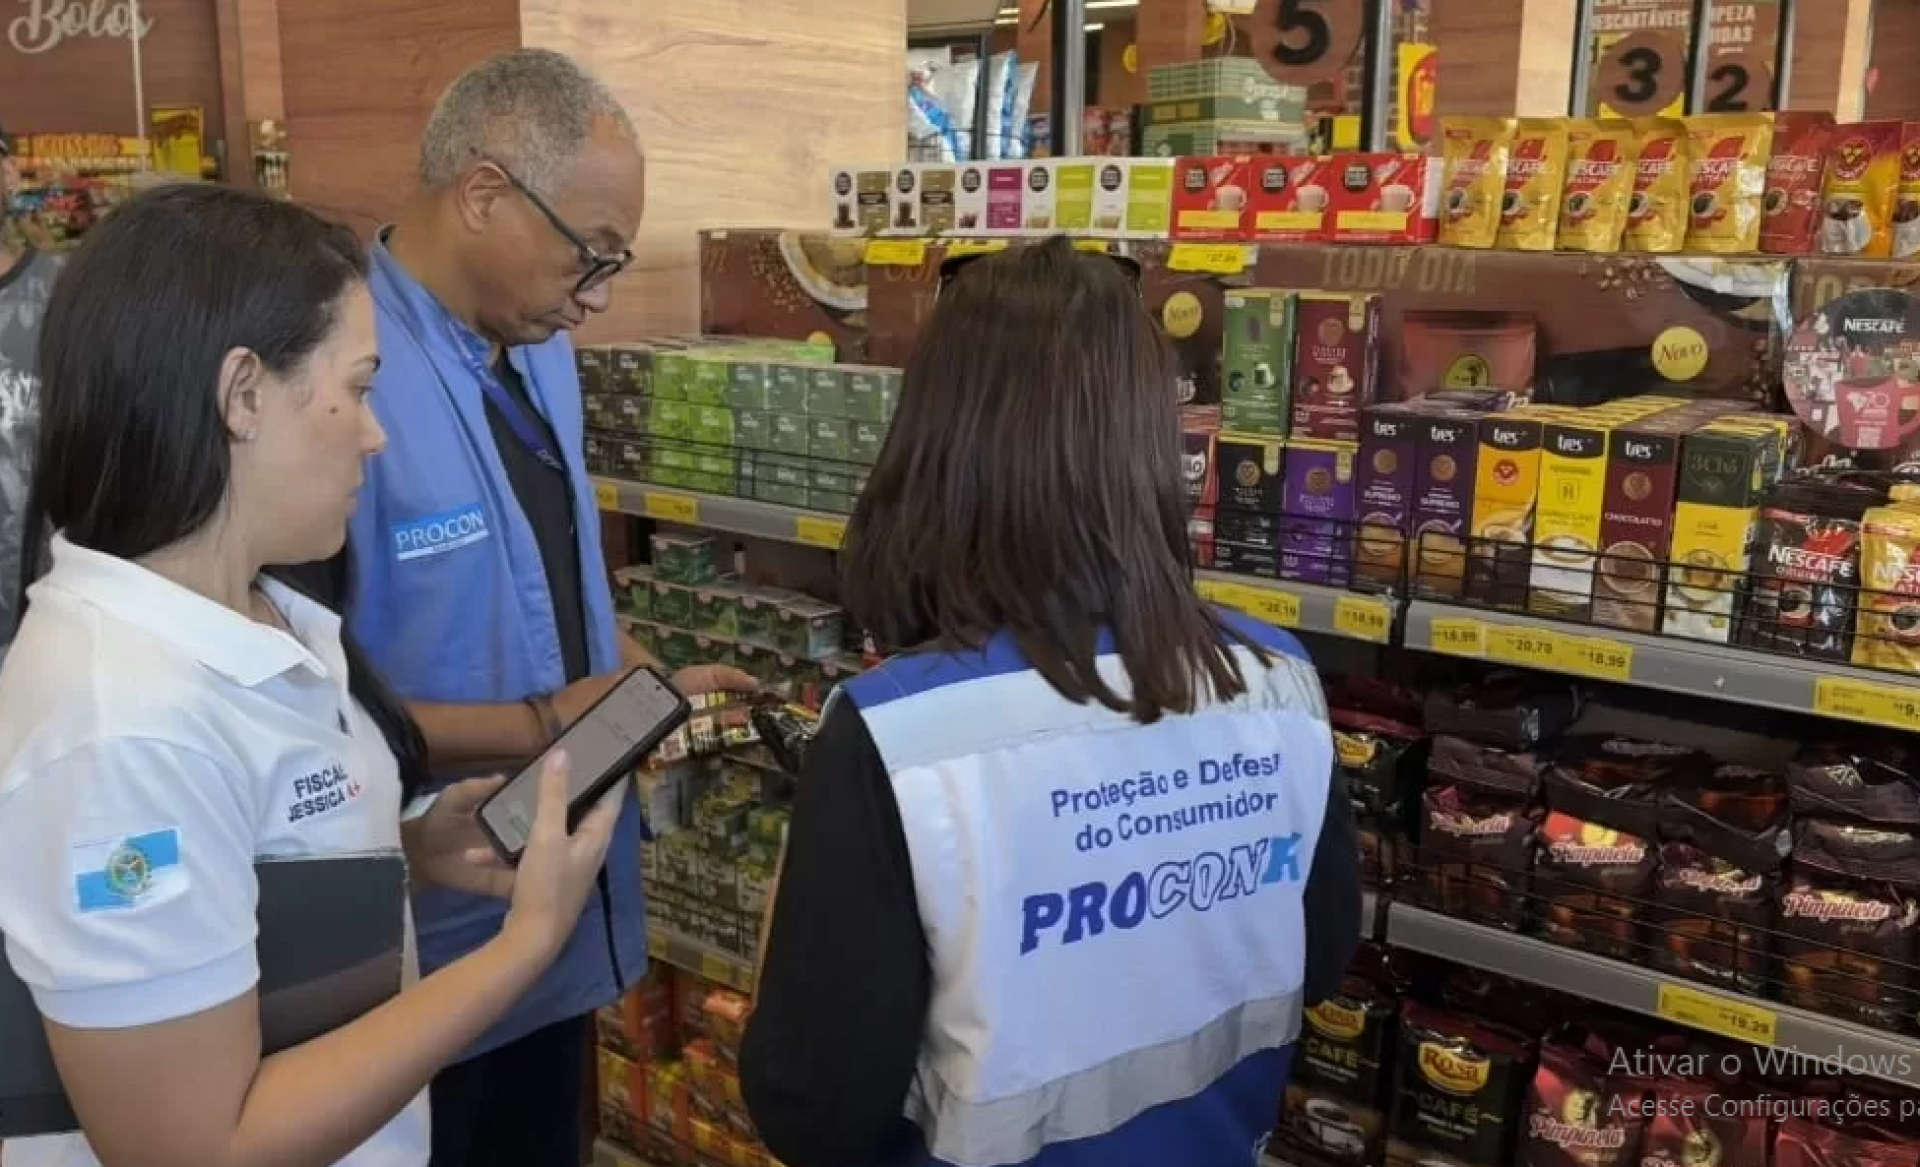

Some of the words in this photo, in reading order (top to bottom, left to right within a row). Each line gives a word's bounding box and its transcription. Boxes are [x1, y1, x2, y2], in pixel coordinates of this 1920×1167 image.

[8, 0, 154, 53] Bolos
[1275, 0, 1329, 65] 5
[1614, 48, 1662, 103] 3
[1708, 64, 1749, 111] 2
[396, 510, 484, 549] PROCON
[293, 763, 348, 799] FISCAL
[1051, 771, 1169, 817] Proteção
[1173, 769, 1188, 789] e
[288, 788, 345, 823] JESSICA
[1075, 824, 1114, 851] do
[1118, 790, 1279, 841] Consumidor
[1783, 891, 1892, 922] Pimpinela
